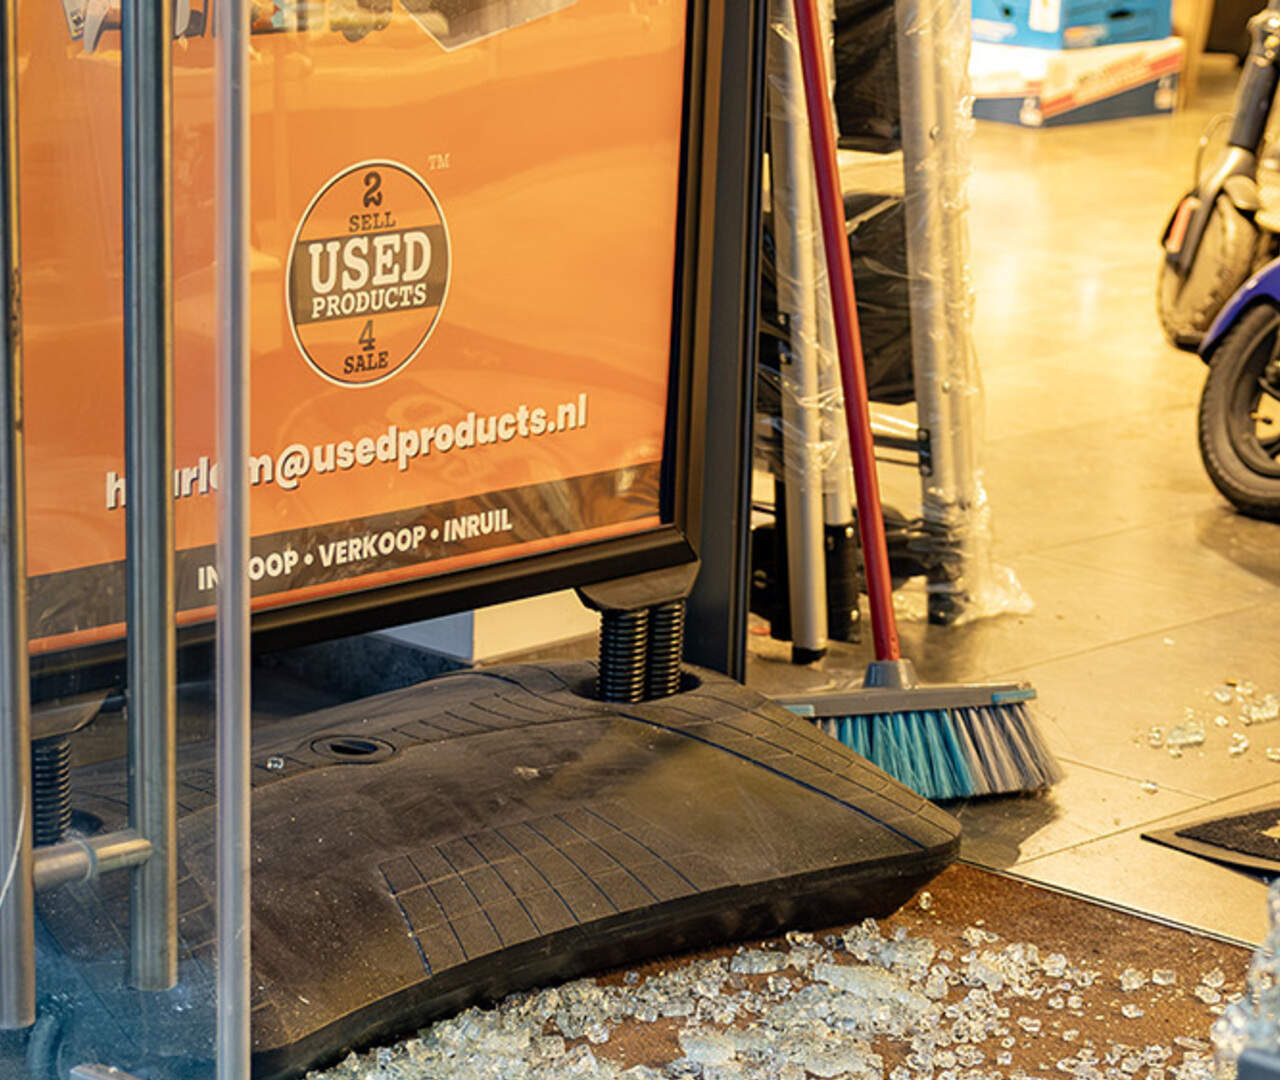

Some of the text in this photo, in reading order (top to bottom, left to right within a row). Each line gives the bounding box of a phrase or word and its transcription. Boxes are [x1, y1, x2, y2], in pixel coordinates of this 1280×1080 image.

[428, 153, 451, 170] TM
[362, 171, 383, 208] 2
[348, 211, 396, 232] SELL
[308, 231, 432, 294] USED
[311, 283, 427, 318] PRODUCTS
[358, 319, 376, 351] 4
[343, 351, 389, 374] SALE
[106, 393, 588, 510] hrlm@usedproducts.nl
[197, 508, 513, 591] INOOP VERKOOP INRUIL
